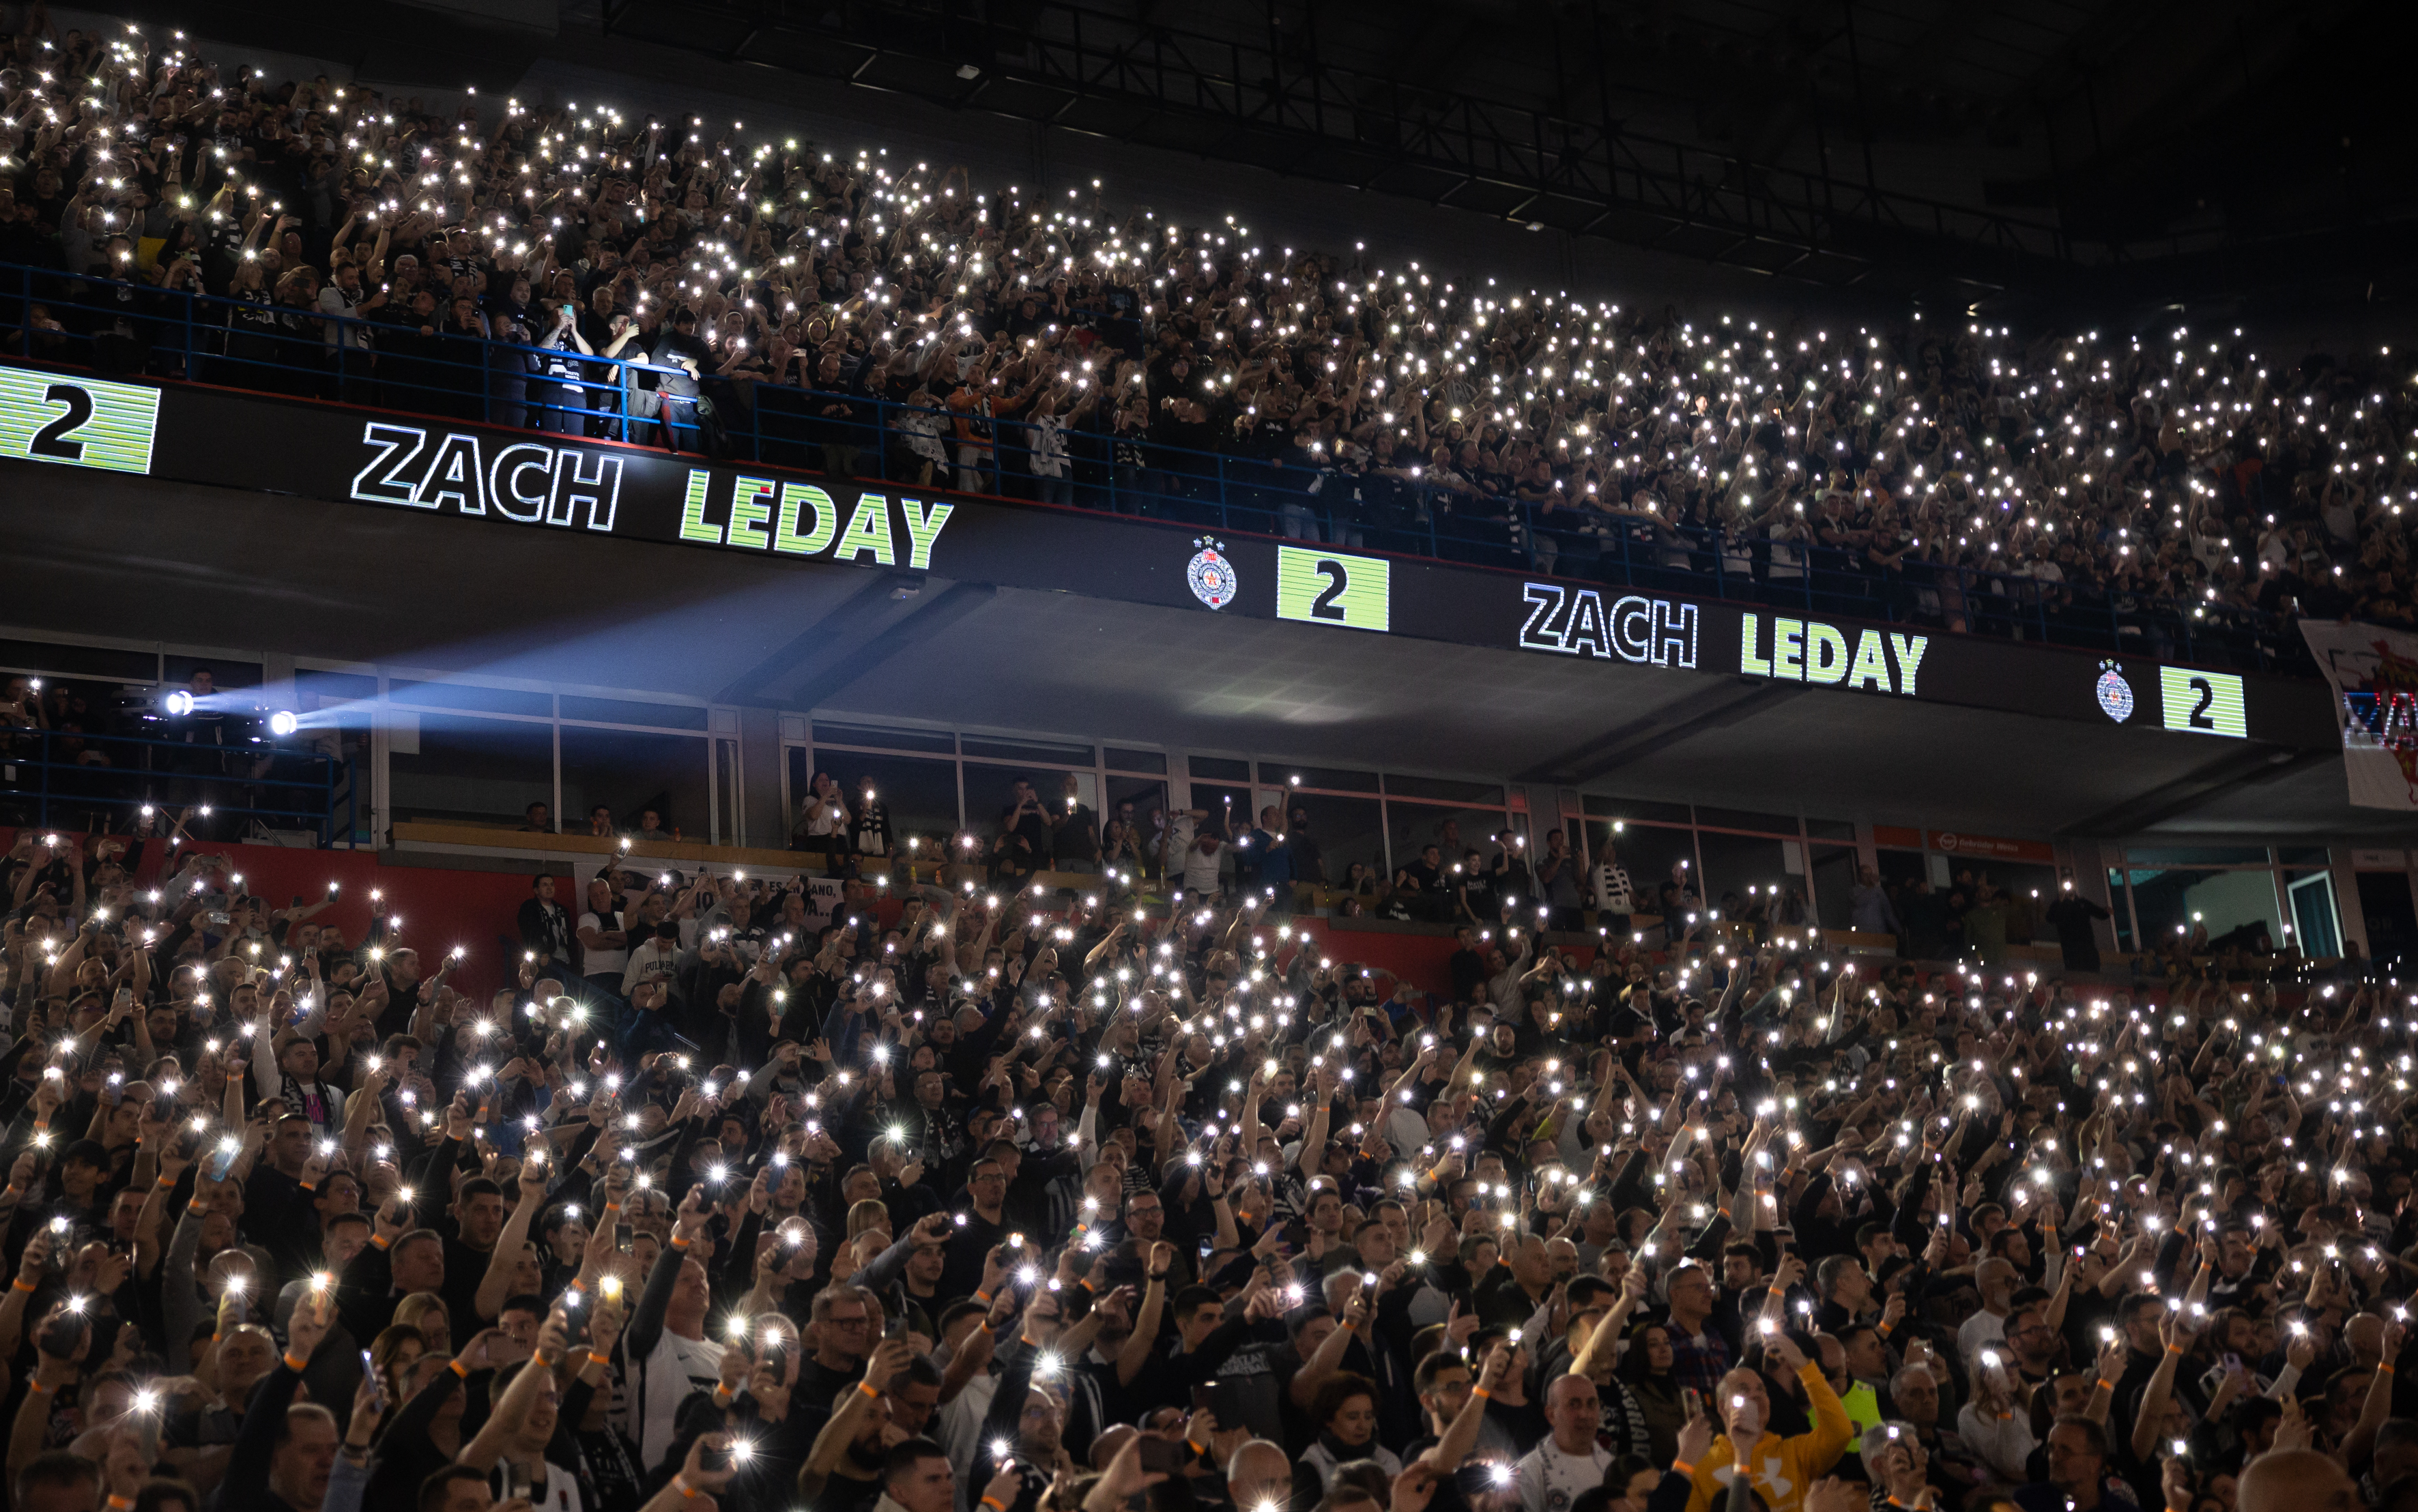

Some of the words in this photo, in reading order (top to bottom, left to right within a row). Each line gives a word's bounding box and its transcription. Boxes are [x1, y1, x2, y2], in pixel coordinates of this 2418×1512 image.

[29, 384, 94, 461] 2
[350, 422, 624, 532] ZACH
[679, 469, 954, 570] LEDAY
[1310, 559, 1349, 620] 2
[1519, 582, 1698, 669] ZACH
[1741, 613, 1927, 695] LEDAY
[2188, 677, 2214, 729] 2
[810, 884, 837, 898] ANO,
